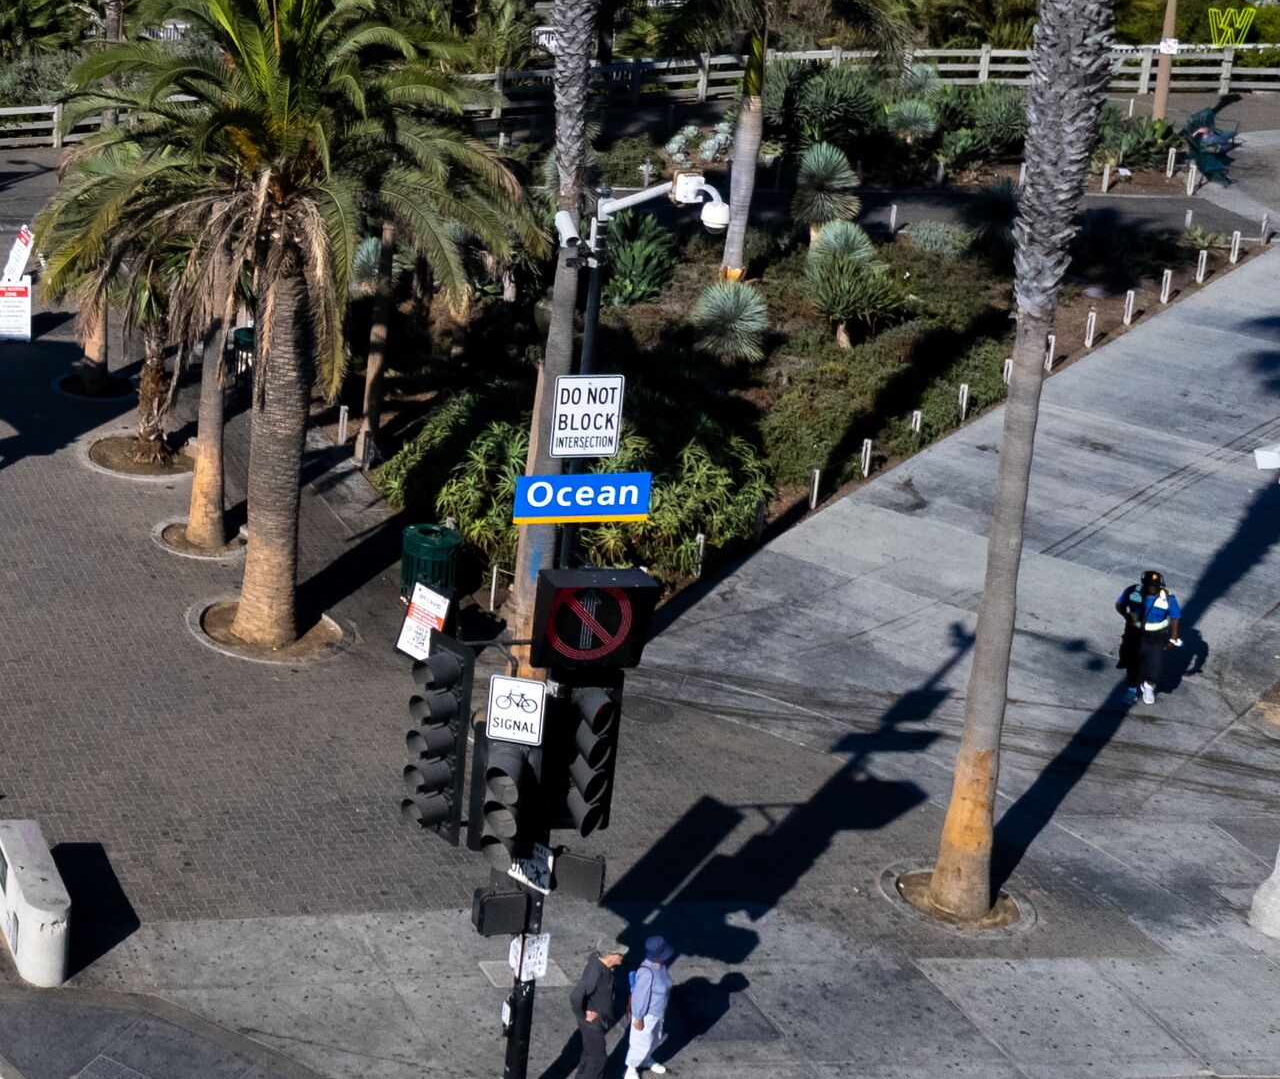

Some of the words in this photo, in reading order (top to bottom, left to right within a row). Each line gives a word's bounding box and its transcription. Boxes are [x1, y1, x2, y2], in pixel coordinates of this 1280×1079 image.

[560, 387, 582, 405] DO
[587, 387, 618, 405] NOT
[558, 413, 615, 431] BLOCK
[555, 436, 614, 449] INTERSECTION
[526, 481, 639, 508] Ocean
[492, 716, 537, 735] SIGNAL
